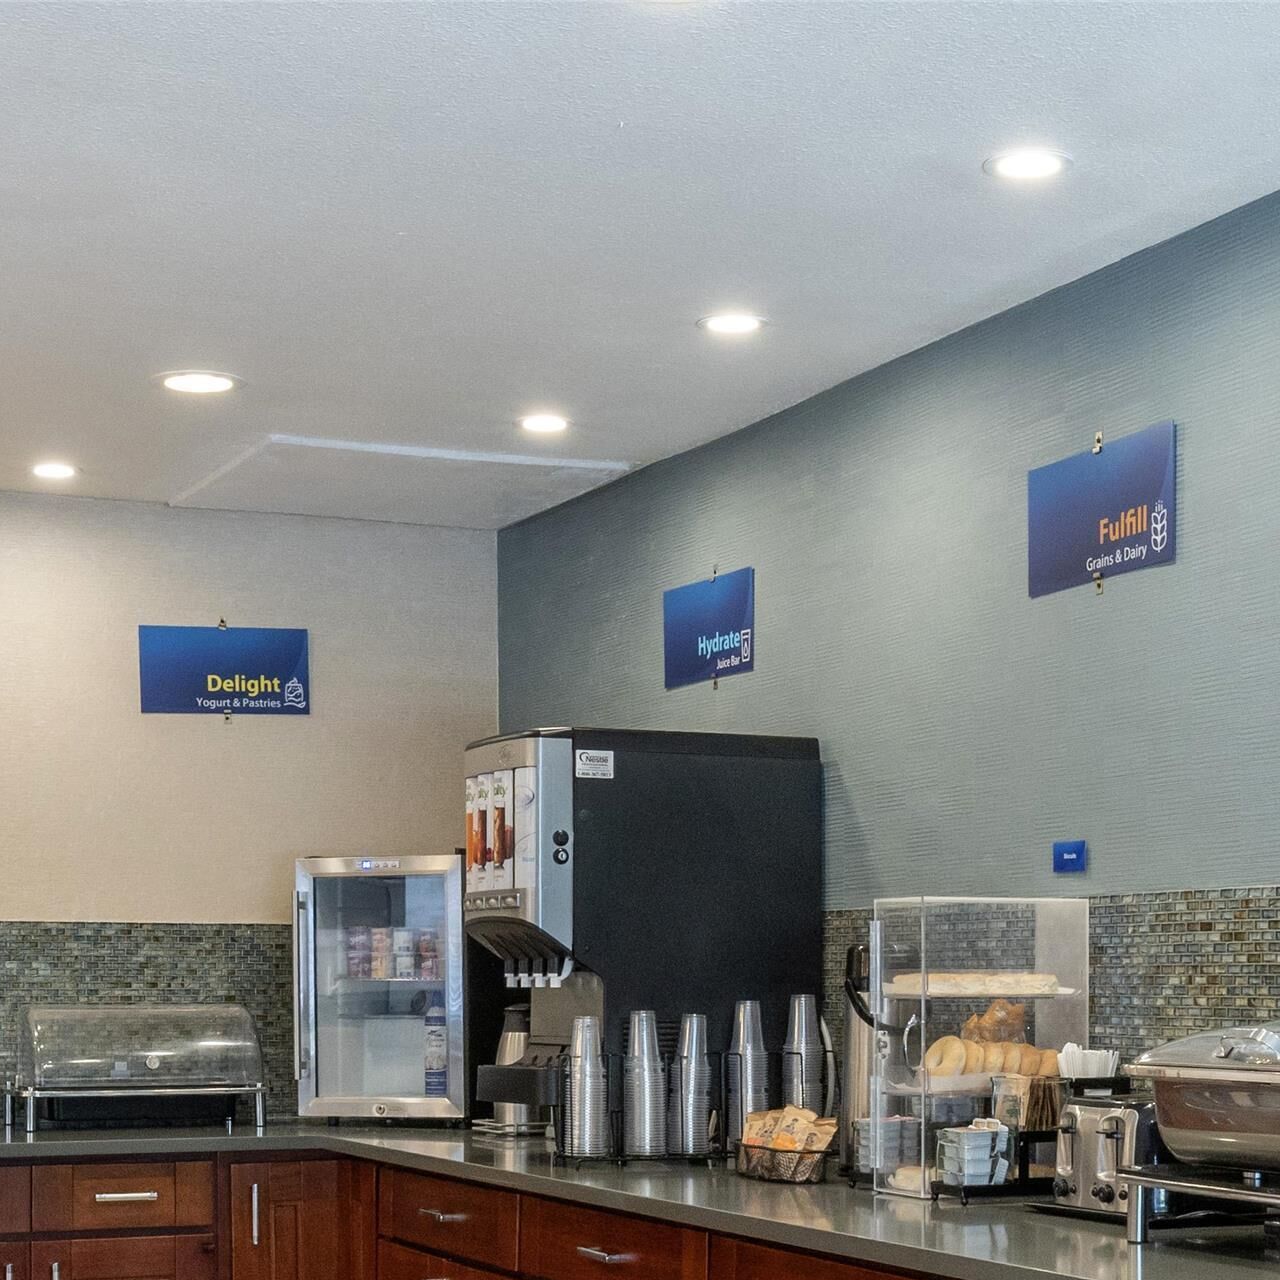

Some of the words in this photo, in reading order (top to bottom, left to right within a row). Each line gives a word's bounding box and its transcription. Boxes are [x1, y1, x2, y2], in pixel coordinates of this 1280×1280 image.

[1099, 504, 1148, 545] Fulfill
[1086, 554, 1114, 571] Grains
[1115, 549, 1123, 564] &
[1123, 544, 1148, 560] Dairy
[698, 631, 741, 659] Hydrate
[716, 657, 730, 670] Juice
[731, 655, 741, 666] Bar
[207, 674, 281, 696] Delight
[196, 697, 231, 709] Yogurt
[233, 698, 241, 707] &
[242, 697, 281, 708] Pastries
